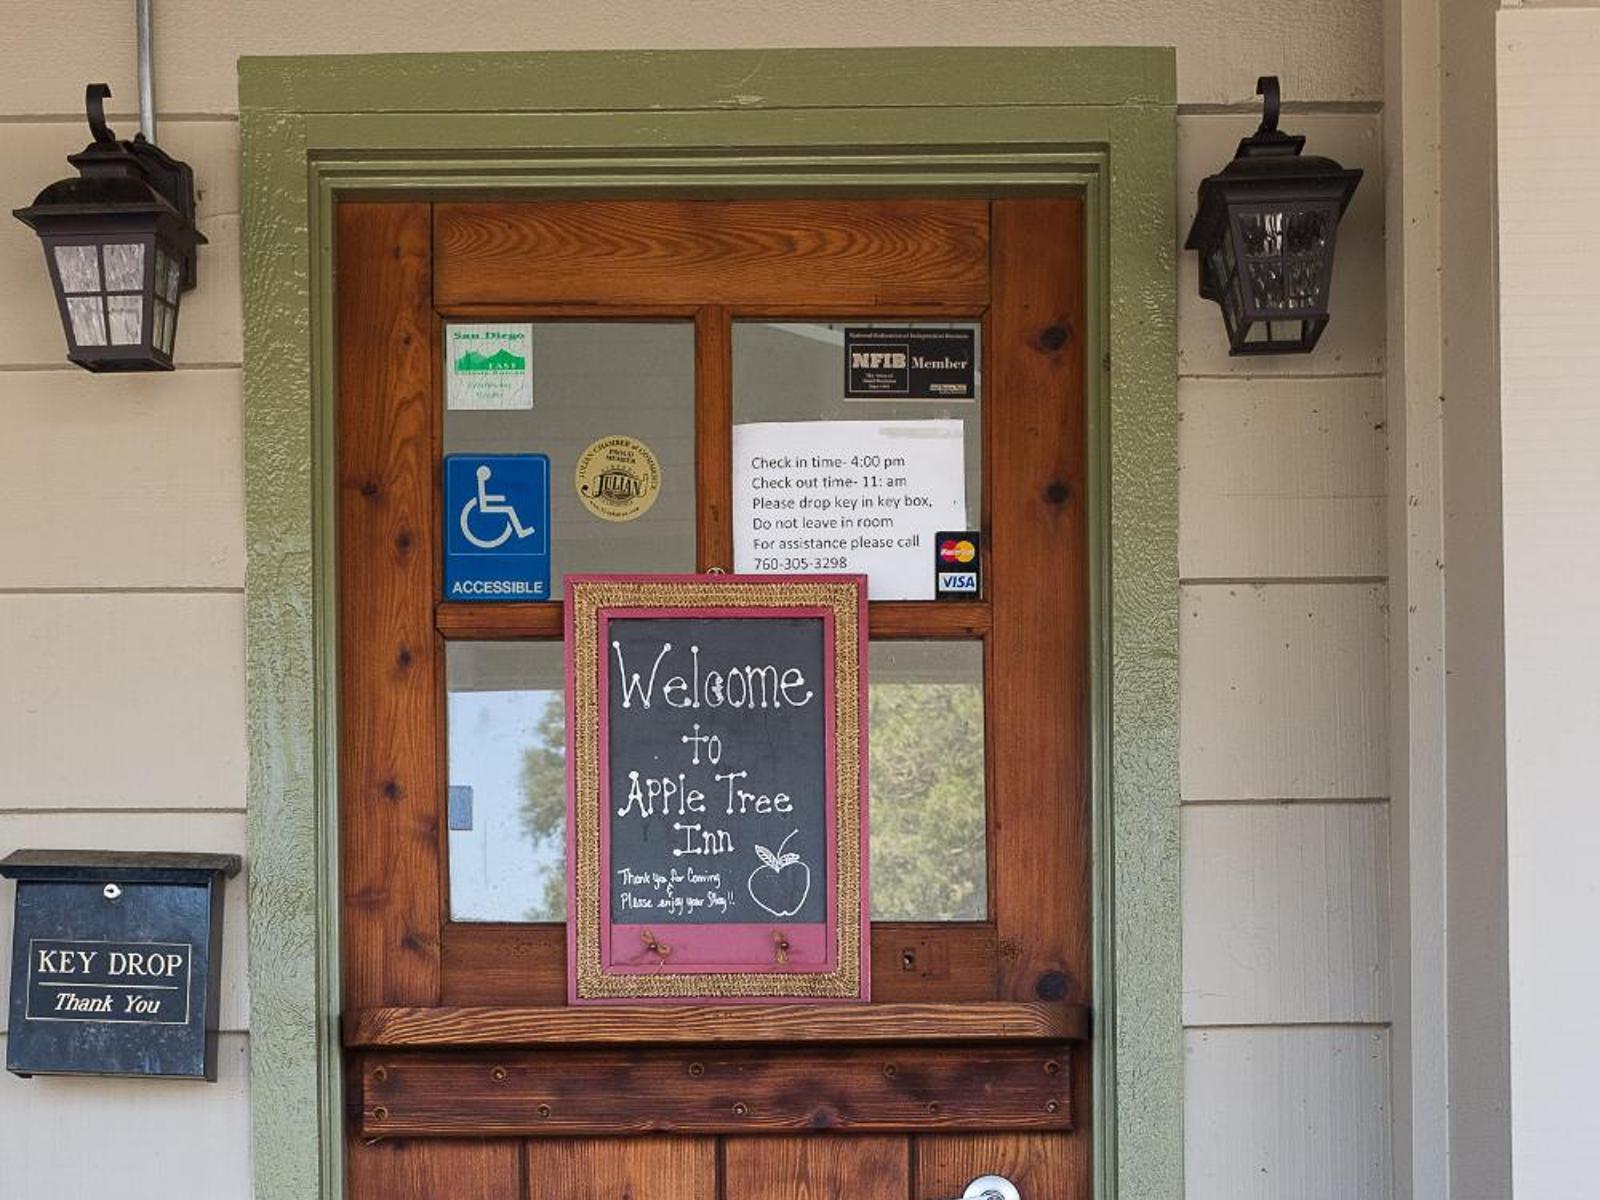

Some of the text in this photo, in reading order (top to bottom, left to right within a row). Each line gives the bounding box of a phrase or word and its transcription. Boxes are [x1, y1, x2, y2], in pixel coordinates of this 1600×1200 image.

[453, 331, 525, 342] San Diego
[852, 352, 968, 369] NFIB Member
[593, 439, 631, 453] CHAMBER
[751, 455, 906, 470] Check in time- 4:00 pm
[592, 474, 642, 498] JULIAN
[751, 476, 907, 489] Check out time- 11: am
[752, 495, 933, 511] Please drop key in key box,
[752, 516, 893, 530] Do not leave in room
[753, 535, 920, 550] For assistance please call
[754, 556, 848, 570] 760-305-3298
[452, 580, 543, 594] ACCESSIBLE
[943, 575, 975, 588] VISA
[612, 640, 813, 710] Welcome
[681, 723, 722, 765] to
[616, 770, 793, 817] Apple Tree
[672, 823, 735, 856] Inn
[617, 867, 650, 885] Thank
[669, 868, 685, 883] for
[620, 892, 653, 910] Please
[656, 897, 684, 916] enjoy
[686, 896, 705, 915] your
[37, 949, 183, 976] KEY DROP
[54, 992, 160, 1014] Thank You
